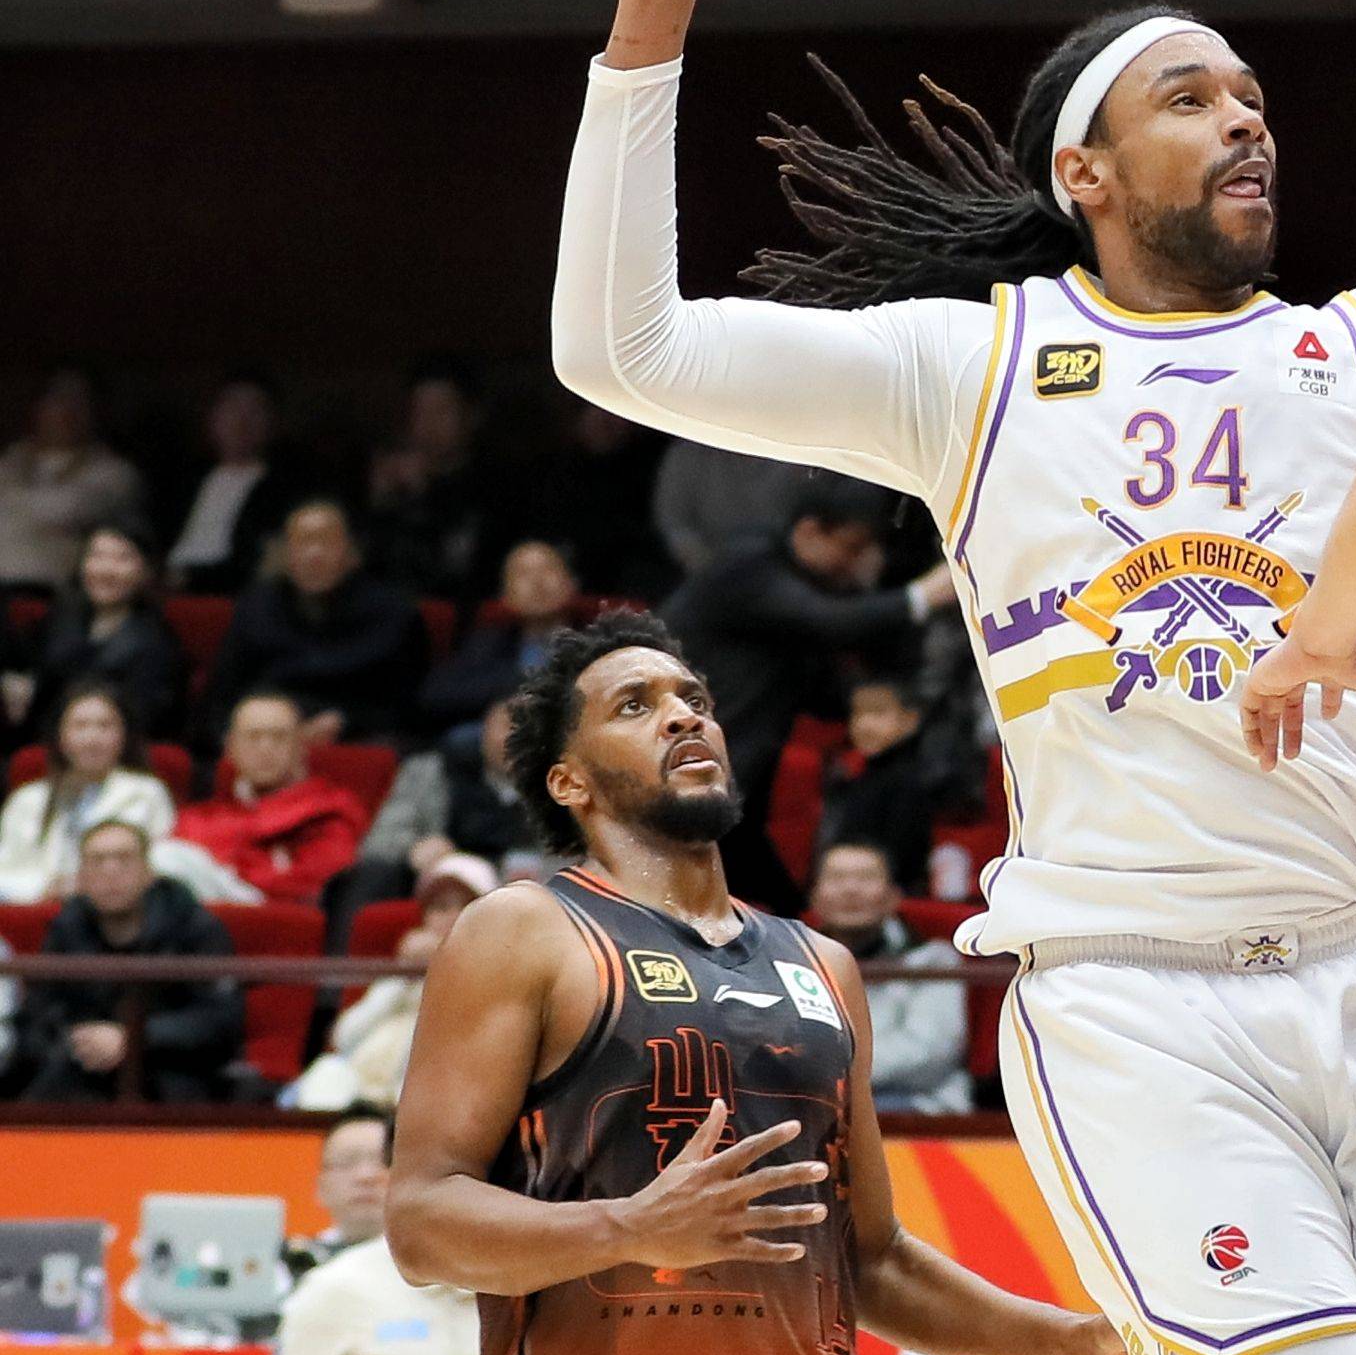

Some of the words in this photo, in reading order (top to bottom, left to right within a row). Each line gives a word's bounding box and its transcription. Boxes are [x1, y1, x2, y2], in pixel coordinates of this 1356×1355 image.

[1299, 381, 1329, 396] CGB
[1123, 405, 1250, 511] 34
[1112, 547, 1176, 595] ROYAL
[1182, 540, 1284, 589] FIGHTERS
[599, 1303, 767, 1320] SHANDONG
